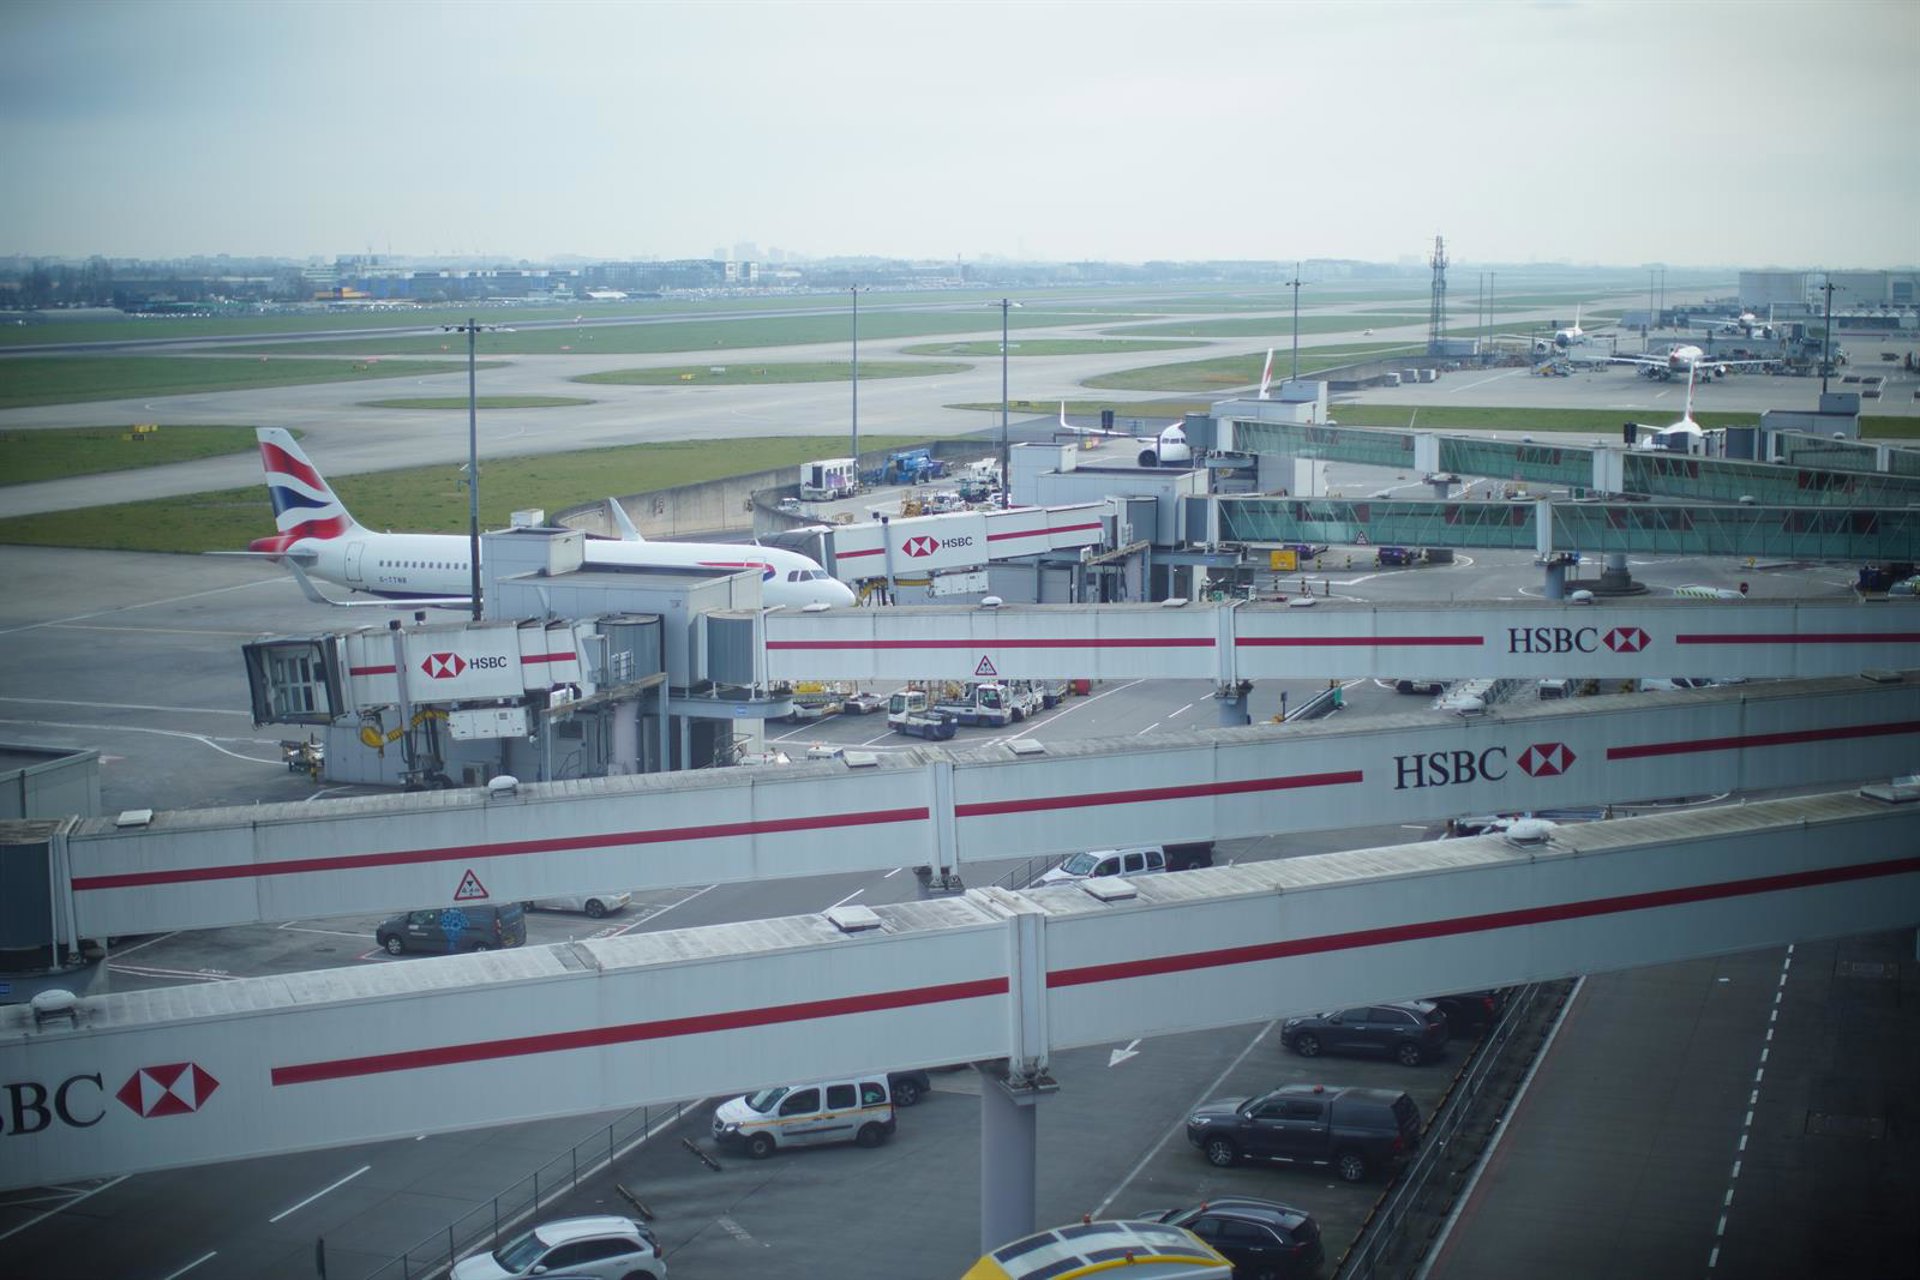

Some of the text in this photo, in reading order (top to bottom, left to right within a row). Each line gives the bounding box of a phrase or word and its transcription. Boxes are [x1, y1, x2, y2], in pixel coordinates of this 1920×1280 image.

[941, 536, 973, 549] HSBC
[1508, 626, 1599, 654] HSBC
[469, 656, 507, 670] HSBC
[1393, 745, 1508, 790] HSBC
[0, 1072, 106, 1136] BC
